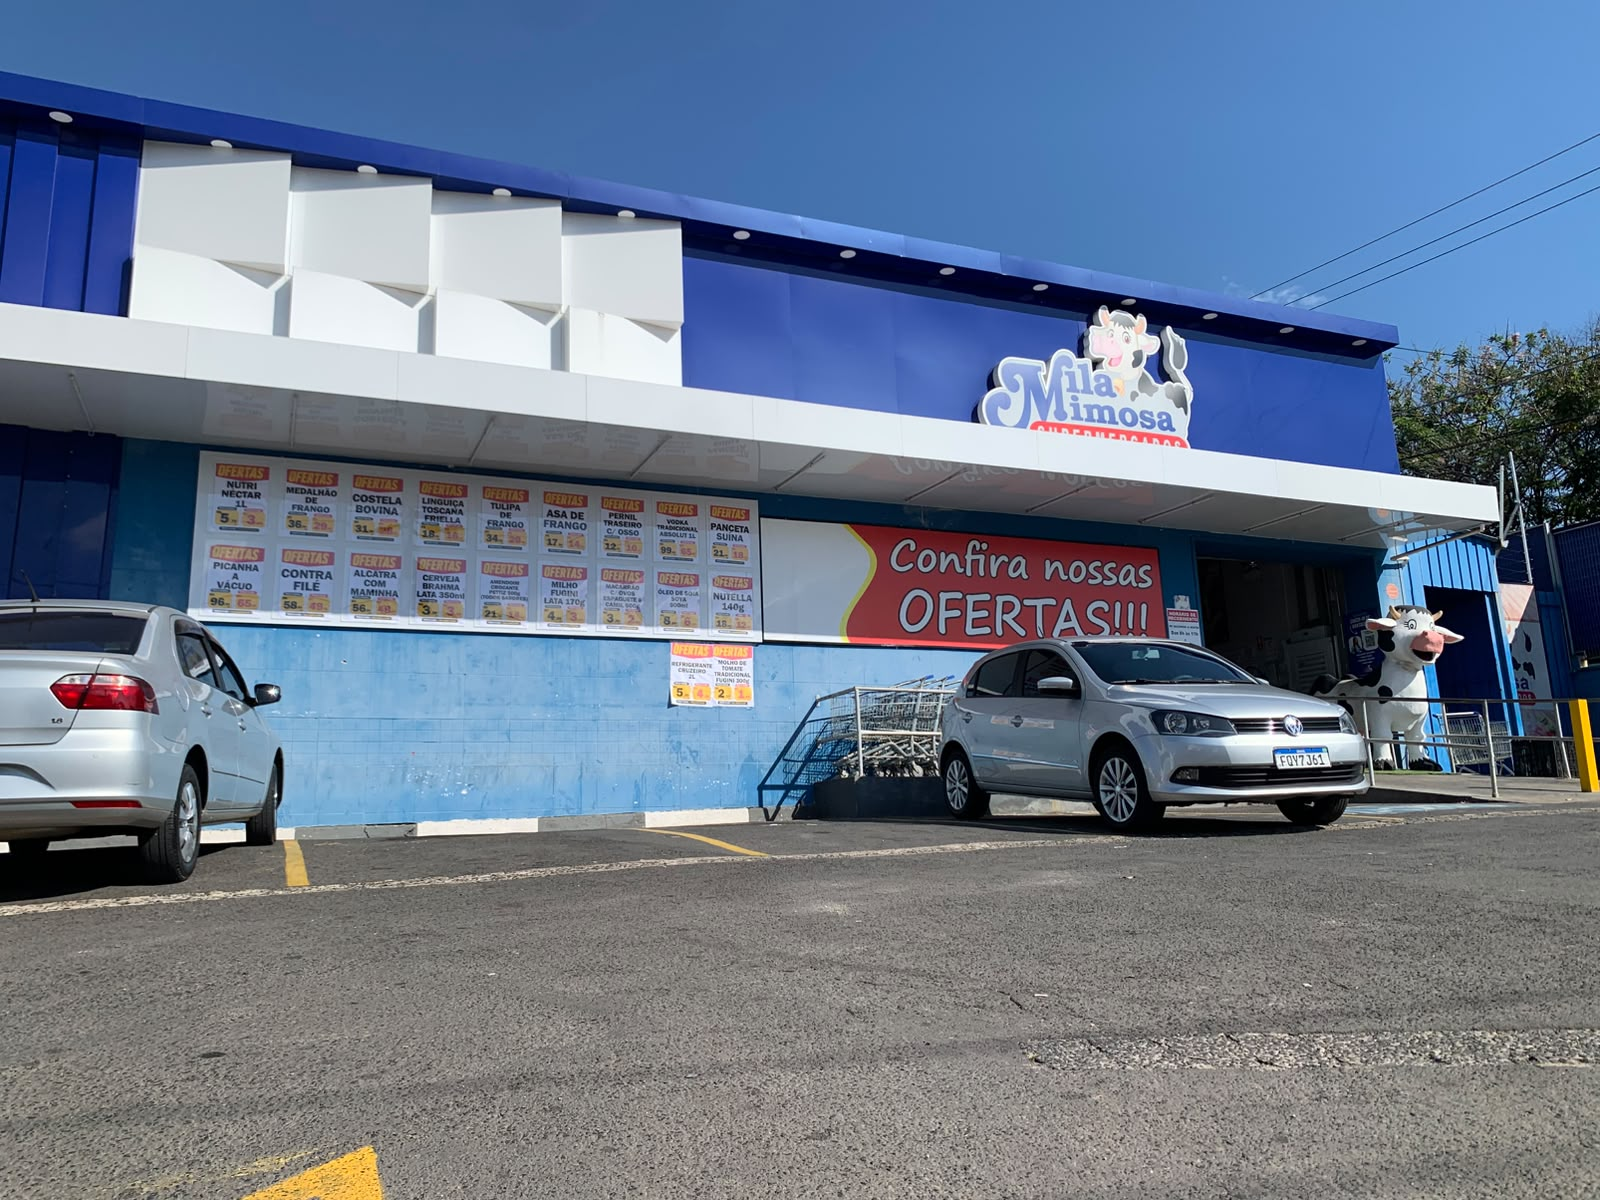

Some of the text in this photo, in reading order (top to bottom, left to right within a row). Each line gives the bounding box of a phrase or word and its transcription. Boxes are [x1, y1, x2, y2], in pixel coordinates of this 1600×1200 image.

[985, 354, 1117, 429] Mila
[217, 464, 264, 479] OFERTAS
[288, 470, 334, 485] OFERTAS
[227, 481, 257, 490] NUTRI
[355, 476, 398, 490] OFERTAS
[286, 487, 337, 497] MEDALHÃO
[421, 483, 463, 496] OFERTAS
[485, 488, 525, 501] OFERTAS
[352, 494, 402, 505] COSTELA
[422, 498, 464, 508] LINGUIÇA
[546, 493, 583, 506] OFERTAS
[291, 504, 330, 513] FRANGO
[356, 505, 398, 515] BOVINA
[490, 502, 520, 511] TULIPA
[603, 499, 640, 511] OFERTAS
[658, 503, 694, 515] OFERTAS
[422, 506, 464, 515] TOSCANA
[546, 510, 584, 520] ASA DE
[712, 508, 746, 519] OFERTAS
[424, 515, 460, 524] FRIELLA
[487, 520, 524, 528] FRANGO
[604, 520, 642, 528] TRASEIRO
[543, 520, 587, 530] FRANGO
[710, 523, 749, 533] PANCETA
[716, 532, 744, 542] SUÍNA
[212, 546, 260, 560] OFERTAS
[284, 550, 330, 564] OFERTAS
[353, 554, 396, 568] OFERTAS
[419, 559, 462, 572] OFERTAS
[890, 539, 1153, 588] Confira nossas
[213, 562, 259, 572] PICANHA
[483, 562, 524, 576] OFERTAS
[281, 569, 332, 580] CONTRA
[354, 570, 397, 579] ALCATRA
[544, 566, 583, 579] OFERTAS
[603, 570, 640, 582] OFERTAS
[423, 574, 460, 583] CERVEJA
[659, 574, 696, 586] OFERTAS
[714, 578, 748, 588] OFERTAS
[217, 580, 252, 590] VÁCUO
[294, 580, 320, 592] FILÉ
[351, 588, 398, 598] MAMINHA
[713, 593, 752, 601] NUTELLA
[722, 603, 744, 612] 140g
[674, 644, 708, 656] OFERTAS
[715, 647, 748, 657] OFERTAS
